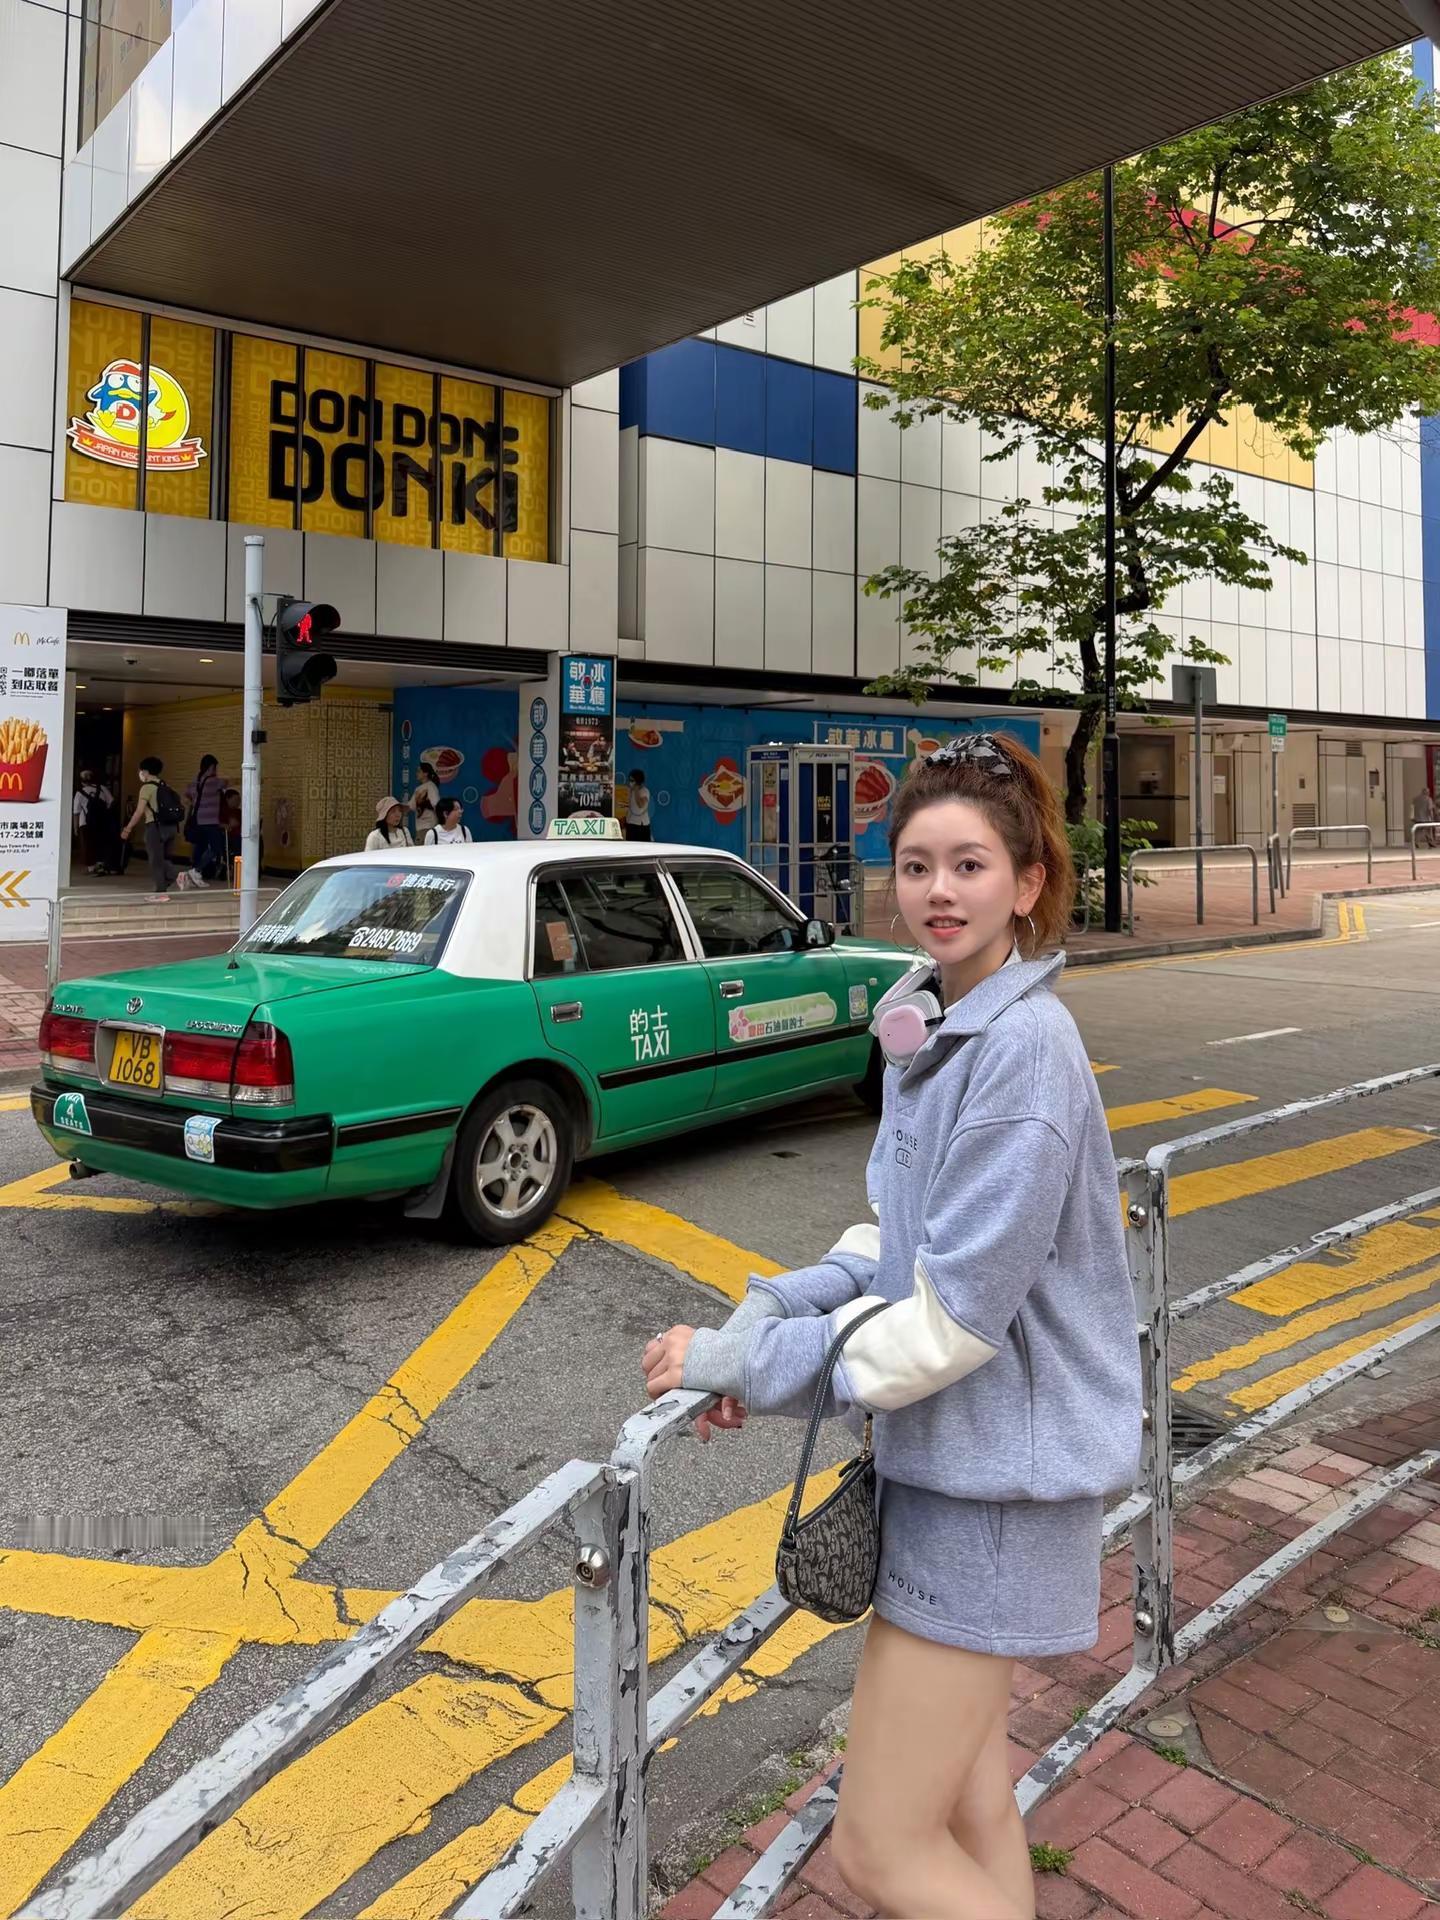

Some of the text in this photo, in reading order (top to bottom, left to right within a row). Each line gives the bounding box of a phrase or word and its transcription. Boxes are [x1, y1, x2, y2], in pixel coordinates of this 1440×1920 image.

[270, 380, 382, 441] DON
[93, 443, 120, 457] JAPAN
[120, 450, 161, 463] DISCNT
[269, 430, 519, 533] DONKI
[11, 680, 58, 691] 到店取餐
[554, 820, 606, 835] TAXI
[361, 928, 423, 953] 2469 2669
[629, 1005, 669, 1034] 的士
[131, 1034, 152, 1060] VB
[631, 1030, 670, 1061] TAXI
[116, 1056, 155, 1085] 1068
[60, 1116, 84, 1130] SEATS
[66, 1103, 75, 1119] 4
[888, 1570, 937, 1606] HOUSE
